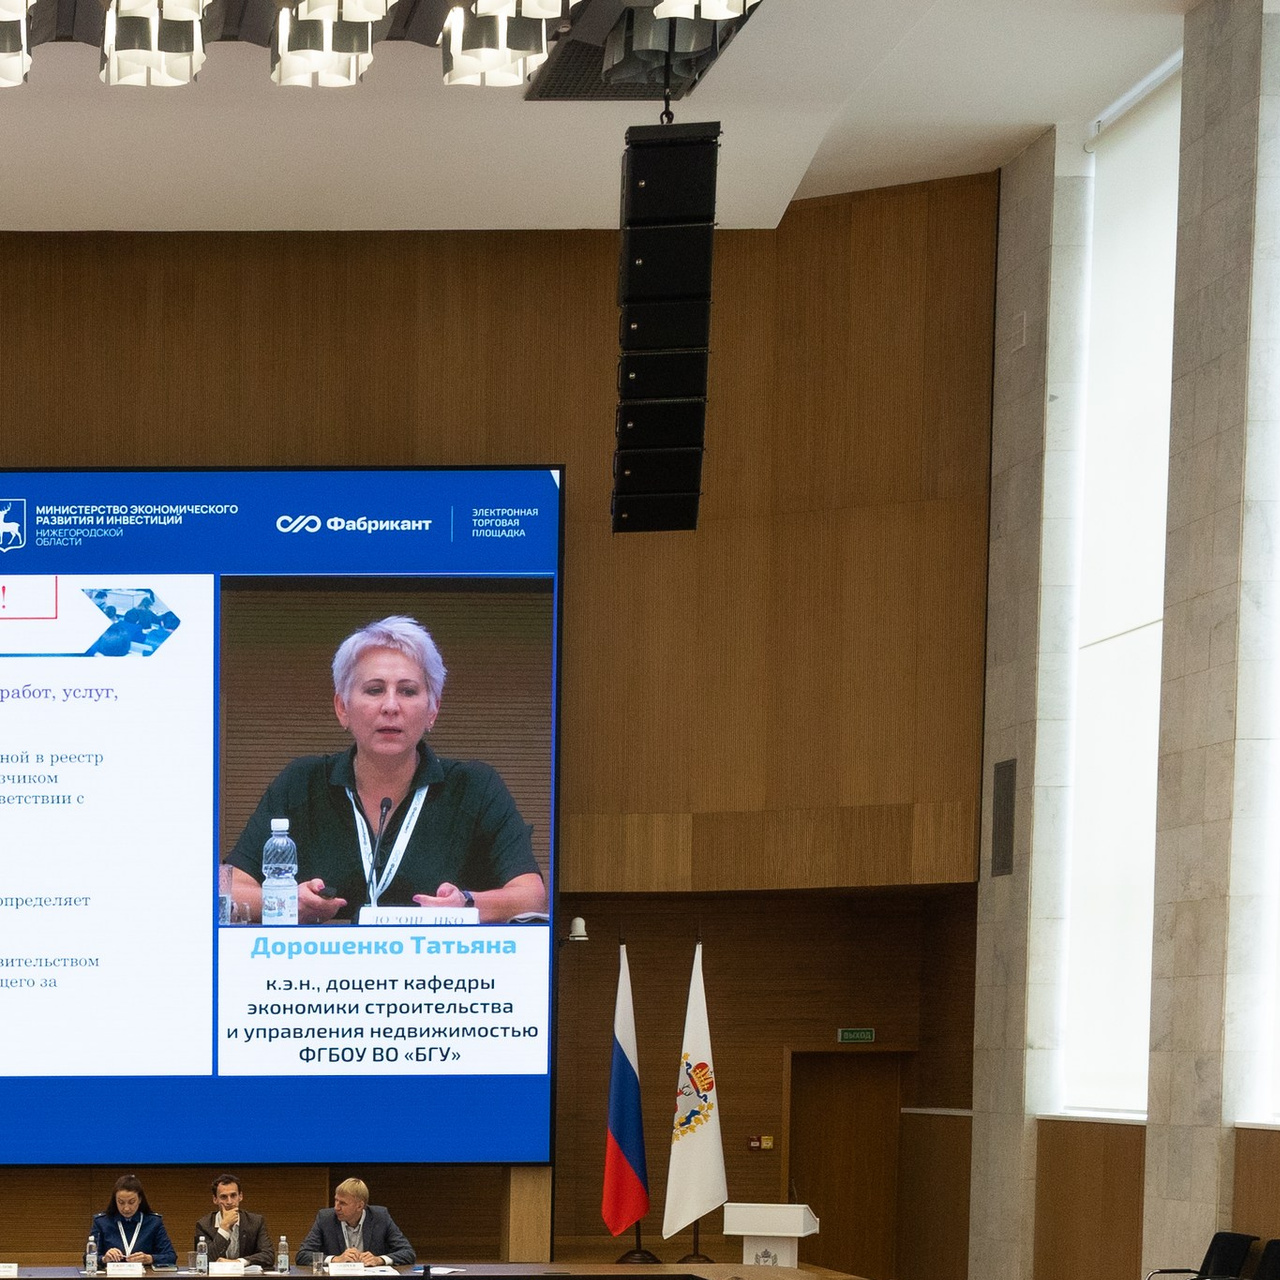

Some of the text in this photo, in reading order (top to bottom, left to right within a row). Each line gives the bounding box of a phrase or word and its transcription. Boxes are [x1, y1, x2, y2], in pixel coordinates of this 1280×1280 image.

[35, 503, 240, 516] МИНИСТЕРСТВО ЭКОНОМИЧЕСКОГО
[471, 507, 540, 518] ЭЛЕКТРОННАЯ
[35, 512, 184, 527] РАЗВИТИЯ И ИНВЕСТИЦИЙ
[326, 516, 433, 534] Фабрикант
[471, 517, 521, 528] ТОРГОВАЯ
[35, 526, 124, 539] НИЖЕГОРОДСКОЙ
[471, 528, 527, 539] ПЛОЩАДКА
[35, 537, 83, 547] ОБЛАСТИ
[0, 683, 56, 703] работ,
[61, 688, 118, 703] услуг,
[35, 754, 45, 764] в
[50, 753, 104, 767] реестр
[76, 794, 85, 805] с
[250, 935, 517, 960] Дорошенко Татьяна
[39, 978, 58, 988] за
[266, 974, 495, 994] к.э.н., доцент кафедры
[247, 1002, 514, 1019] экономики строительства
[227, 1025, 539, 1043] и управления недвижимостью
[843, 1031, 872, 1040] ВЫХОД
[299, 1046, 461, 1064] ФГБОУ ВО «БГУ»
